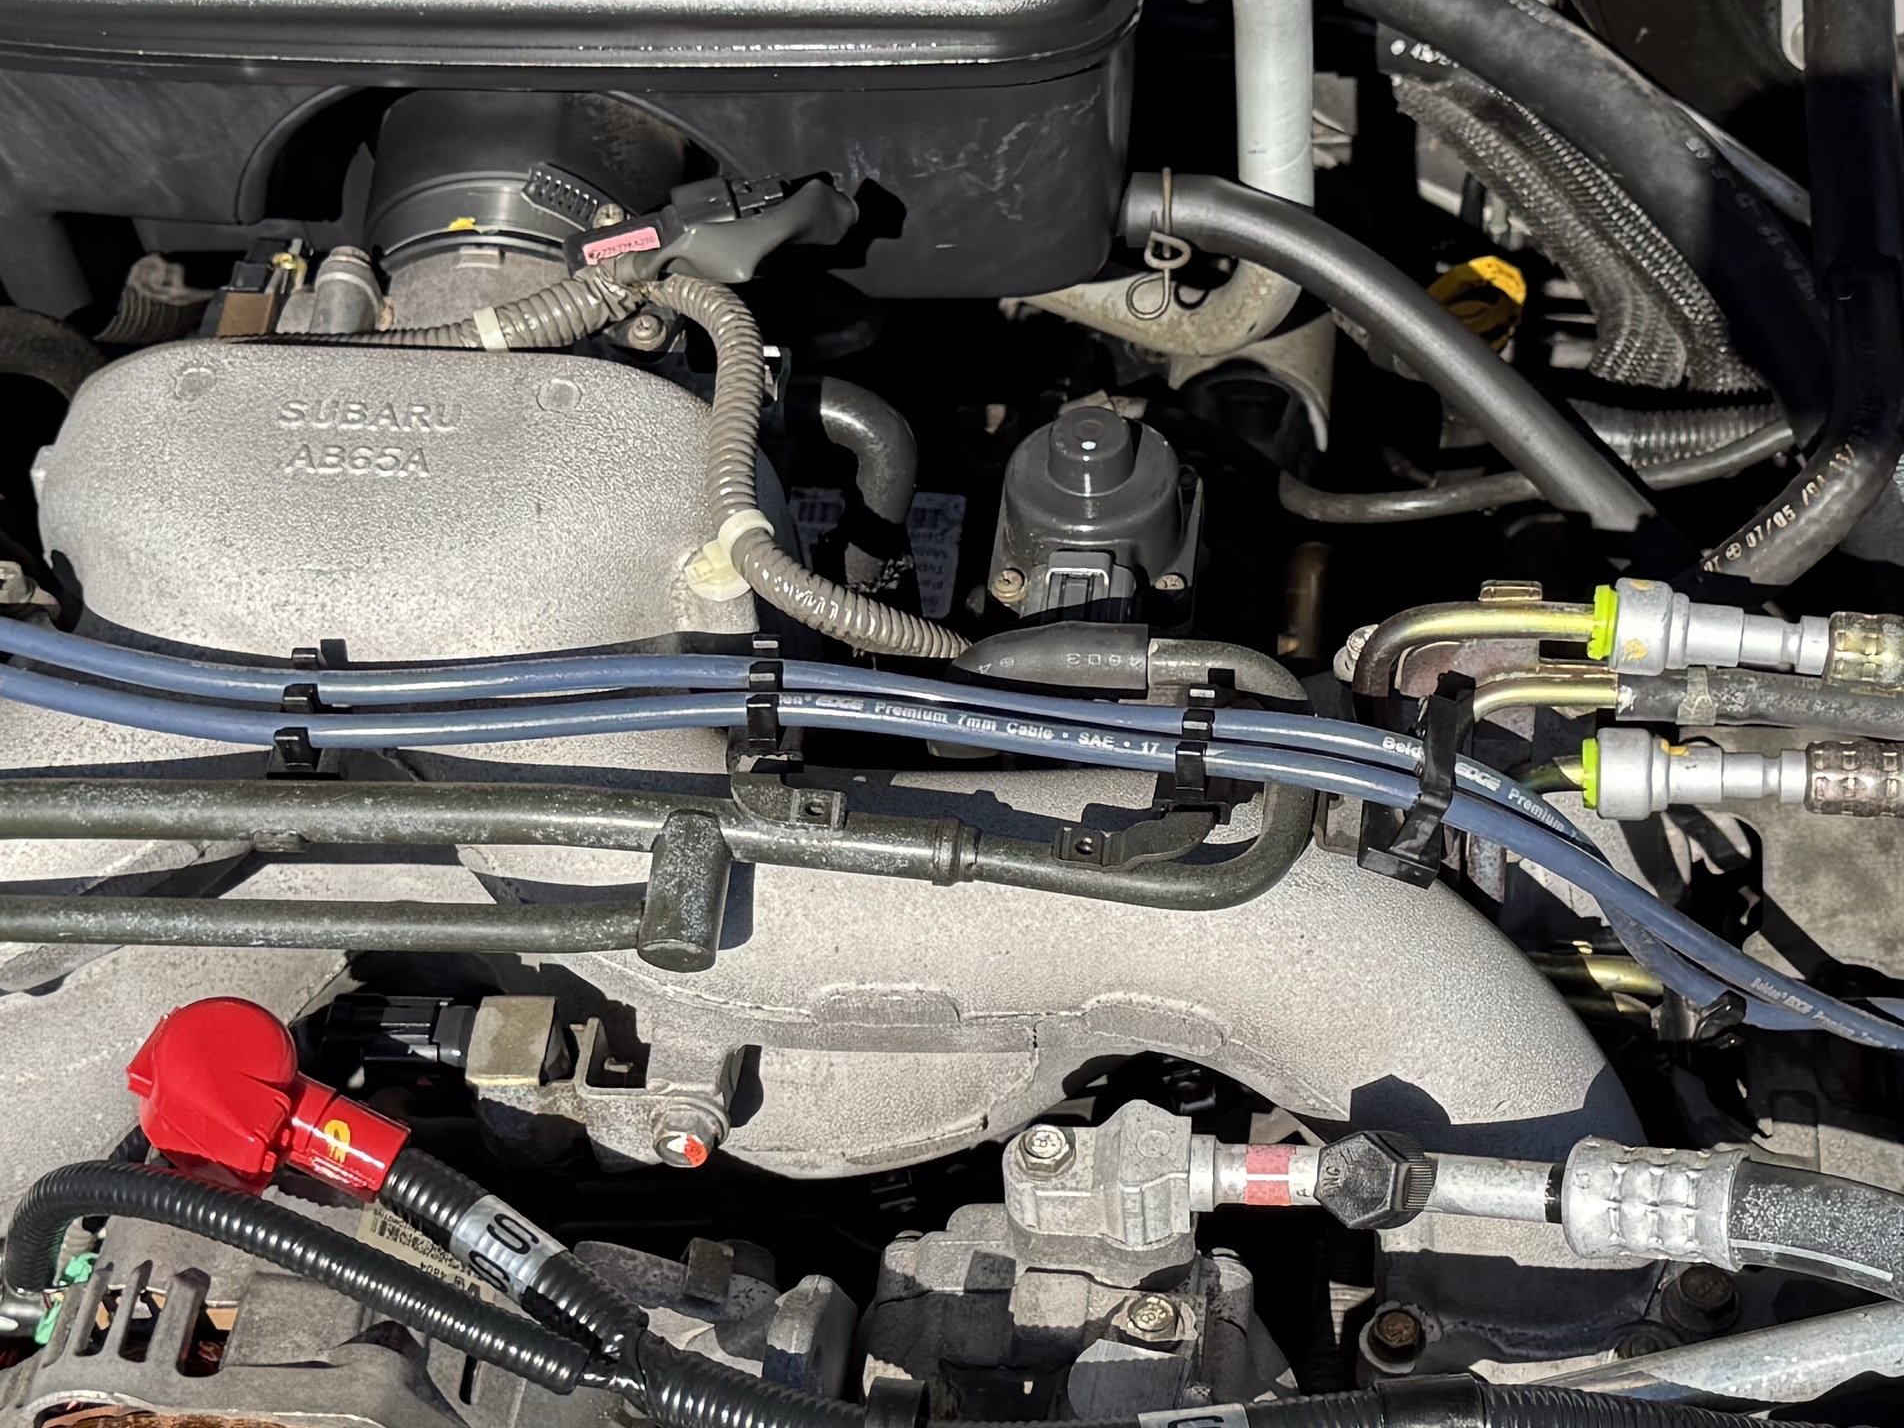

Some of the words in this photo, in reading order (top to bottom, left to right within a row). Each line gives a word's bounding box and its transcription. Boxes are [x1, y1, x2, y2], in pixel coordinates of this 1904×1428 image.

[278, 400, 464, 432] SUBARU
[875, 702, 949, 723] Premium
[958, 714, 997, 733] 7mm
[1006, 722, 1054, 741] Cable
[1079, 733, 1115, 749] SAE
[1141, 741, 1161, 755] 17
